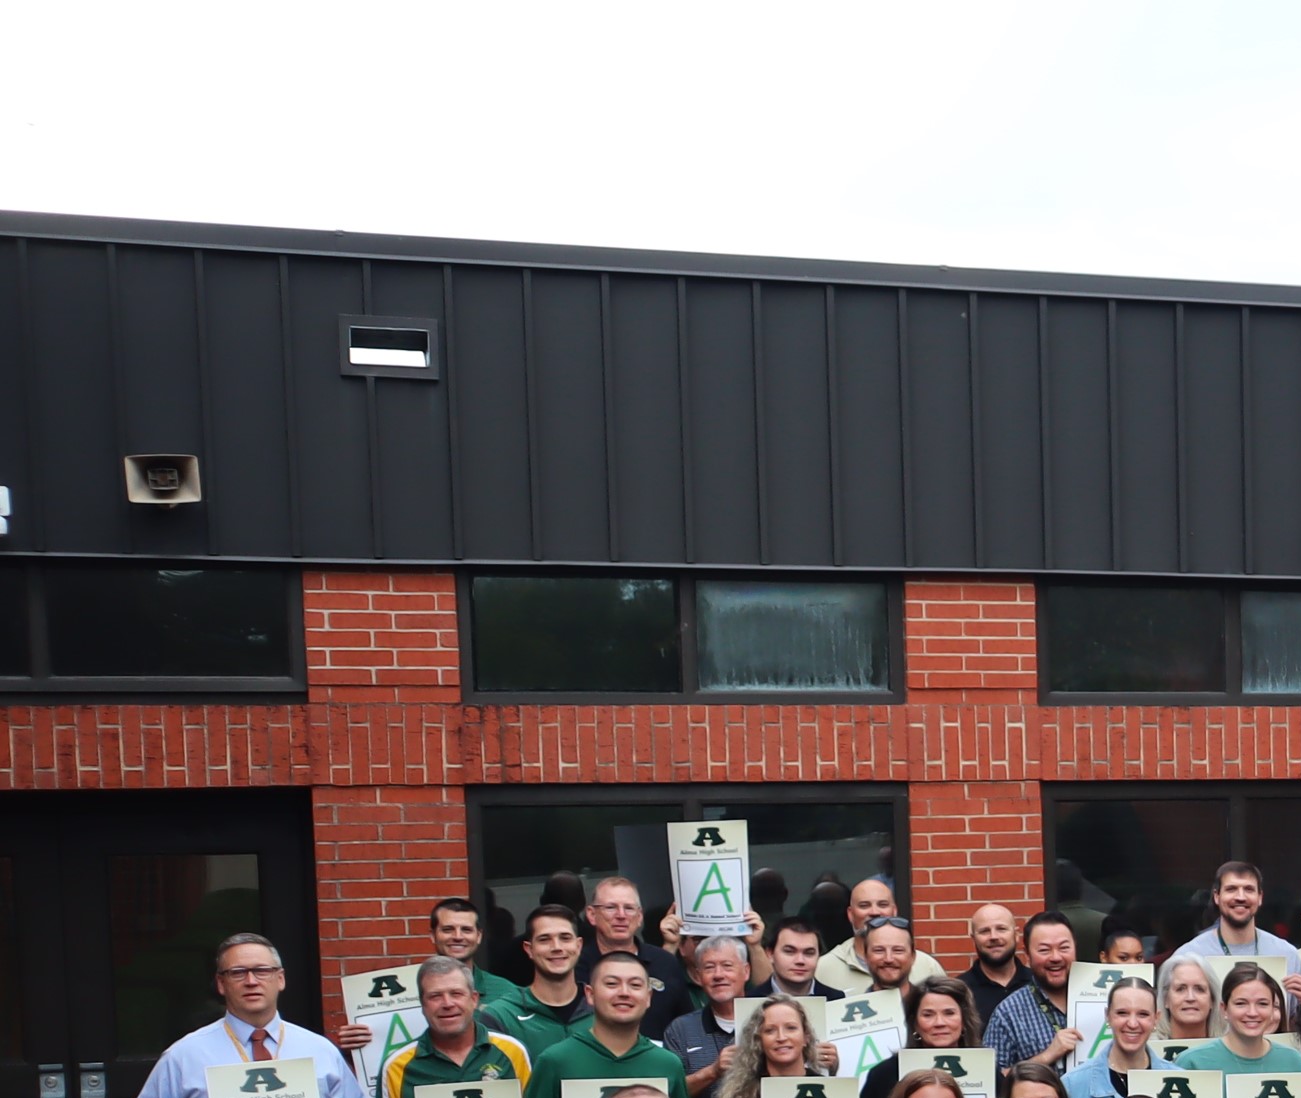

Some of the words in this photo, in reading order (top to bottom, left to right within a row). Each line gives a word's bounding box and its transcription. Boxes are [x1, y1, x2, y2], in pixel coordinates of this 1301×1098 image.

[692, 826, 725, 846] A
[692, 861, 732, 913] A
[240, 1066, 286, 1093] A
